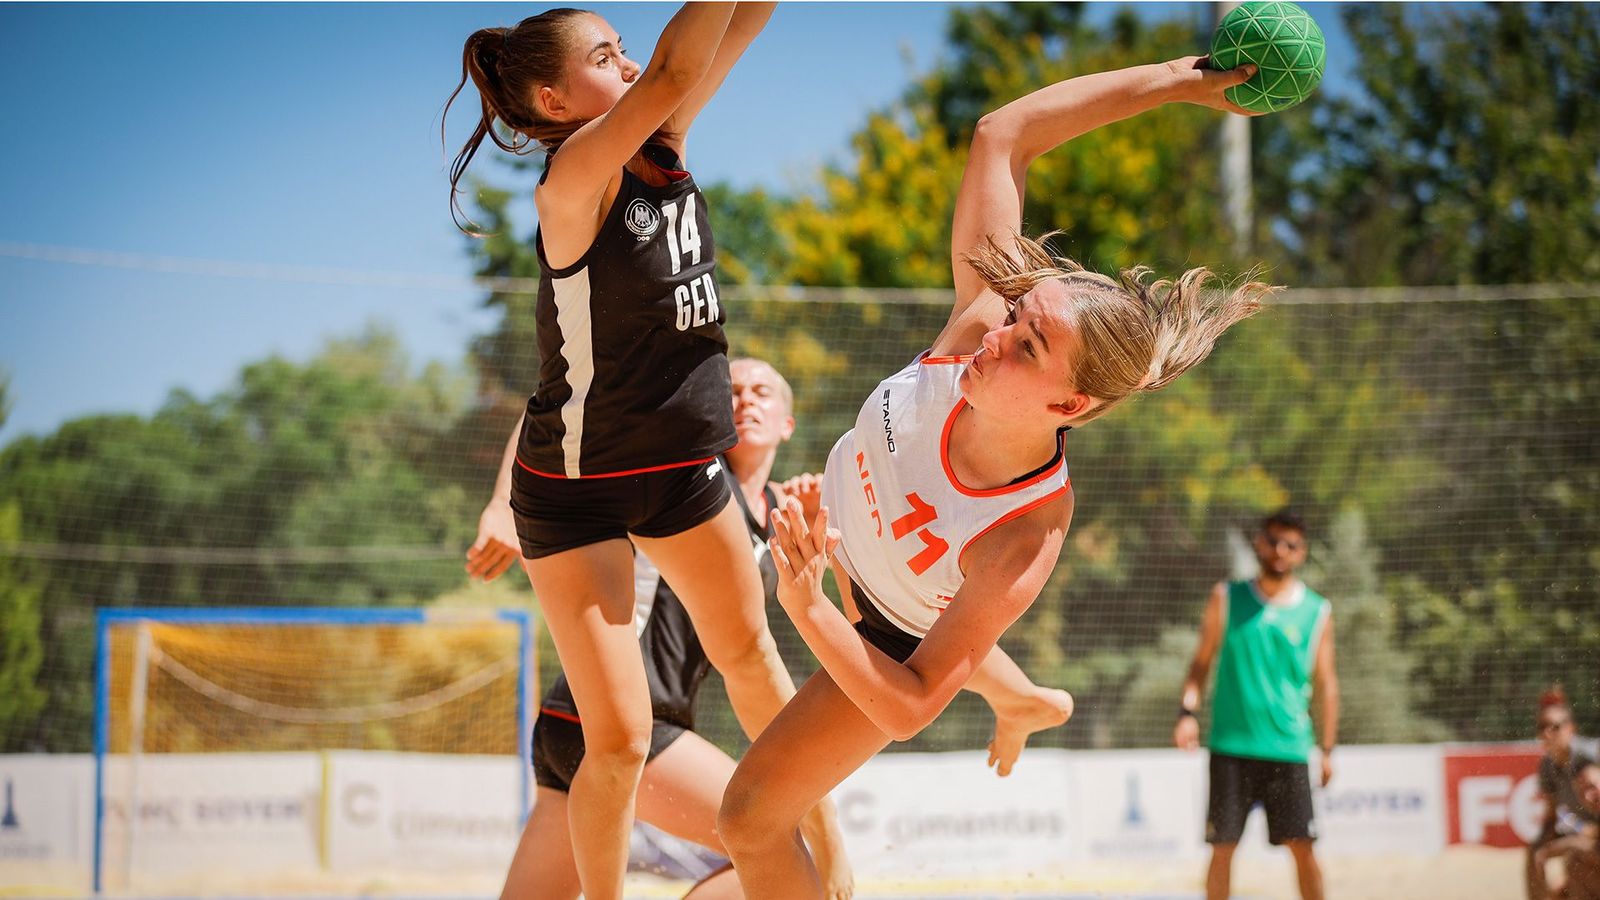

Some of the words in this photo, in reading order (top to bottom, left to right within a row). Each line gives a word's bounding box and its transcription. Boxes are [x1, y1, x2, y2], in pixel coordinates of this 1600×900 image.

[661, 192, 701, 275] 14
[674, 273, 719, 331] GER
[882, 388, 896, 453] STANNO
[891, 492, 950, 576] 11
